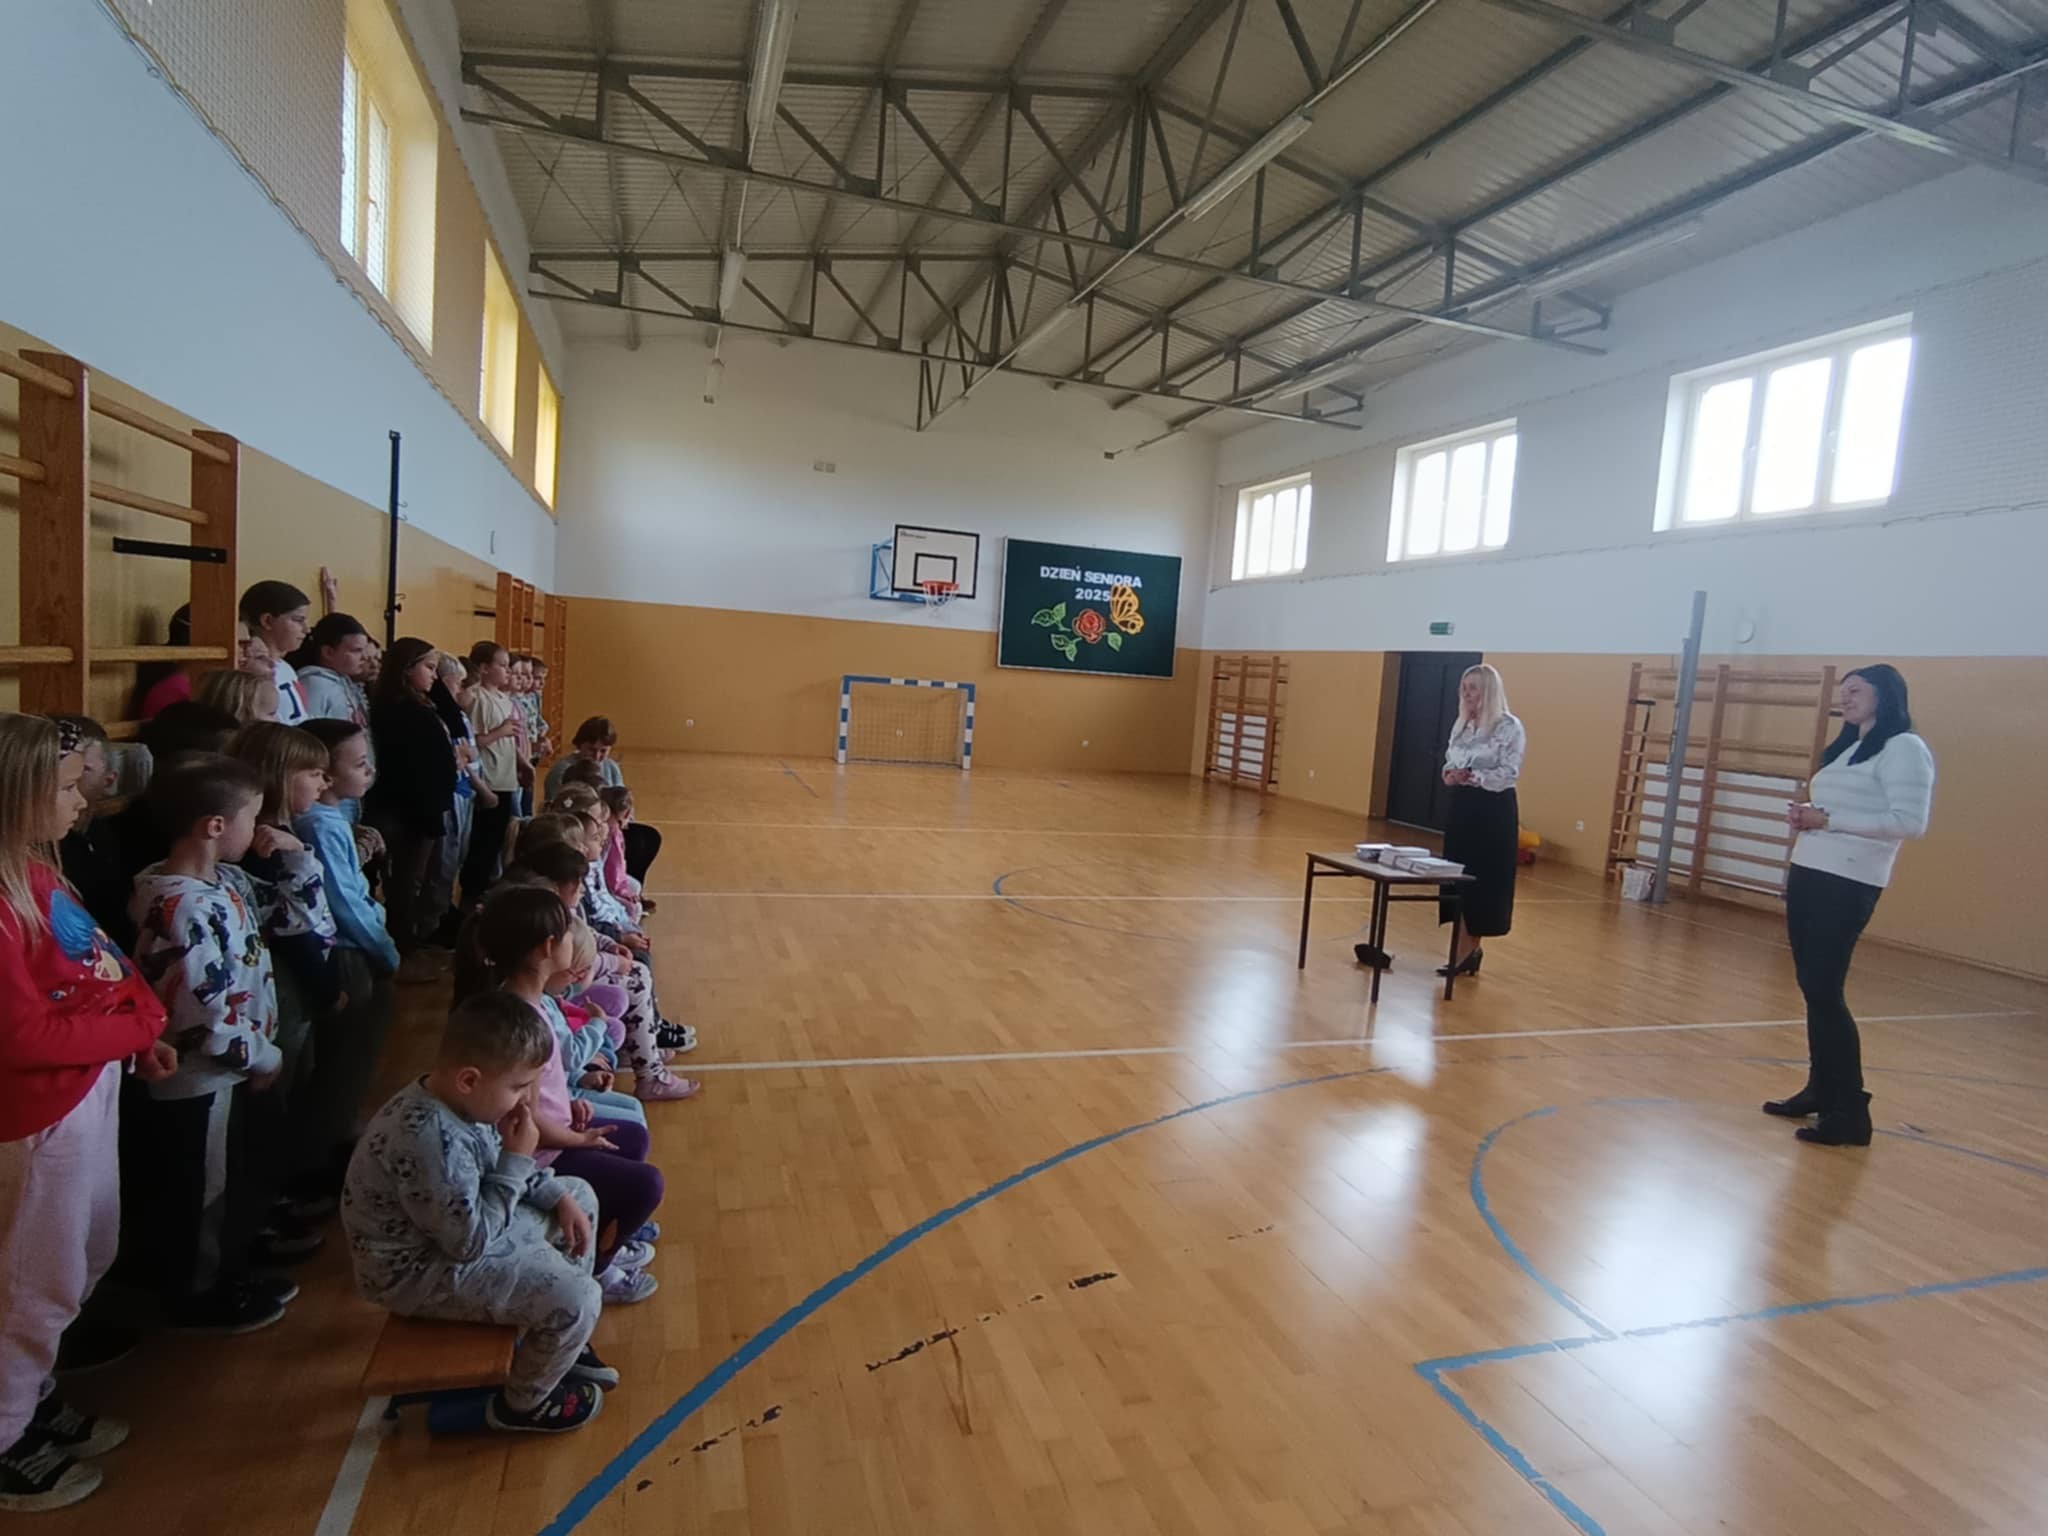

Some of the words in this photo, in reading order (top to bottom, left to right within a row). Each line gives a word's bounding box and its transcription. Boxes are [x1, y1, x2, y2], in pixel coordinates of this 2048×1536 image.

[1040, 566, 1082, 582] DZIEŃ
[1084, 572, 1143, 588] SENIORA
[1075, 588, 1111, 602] 2025
